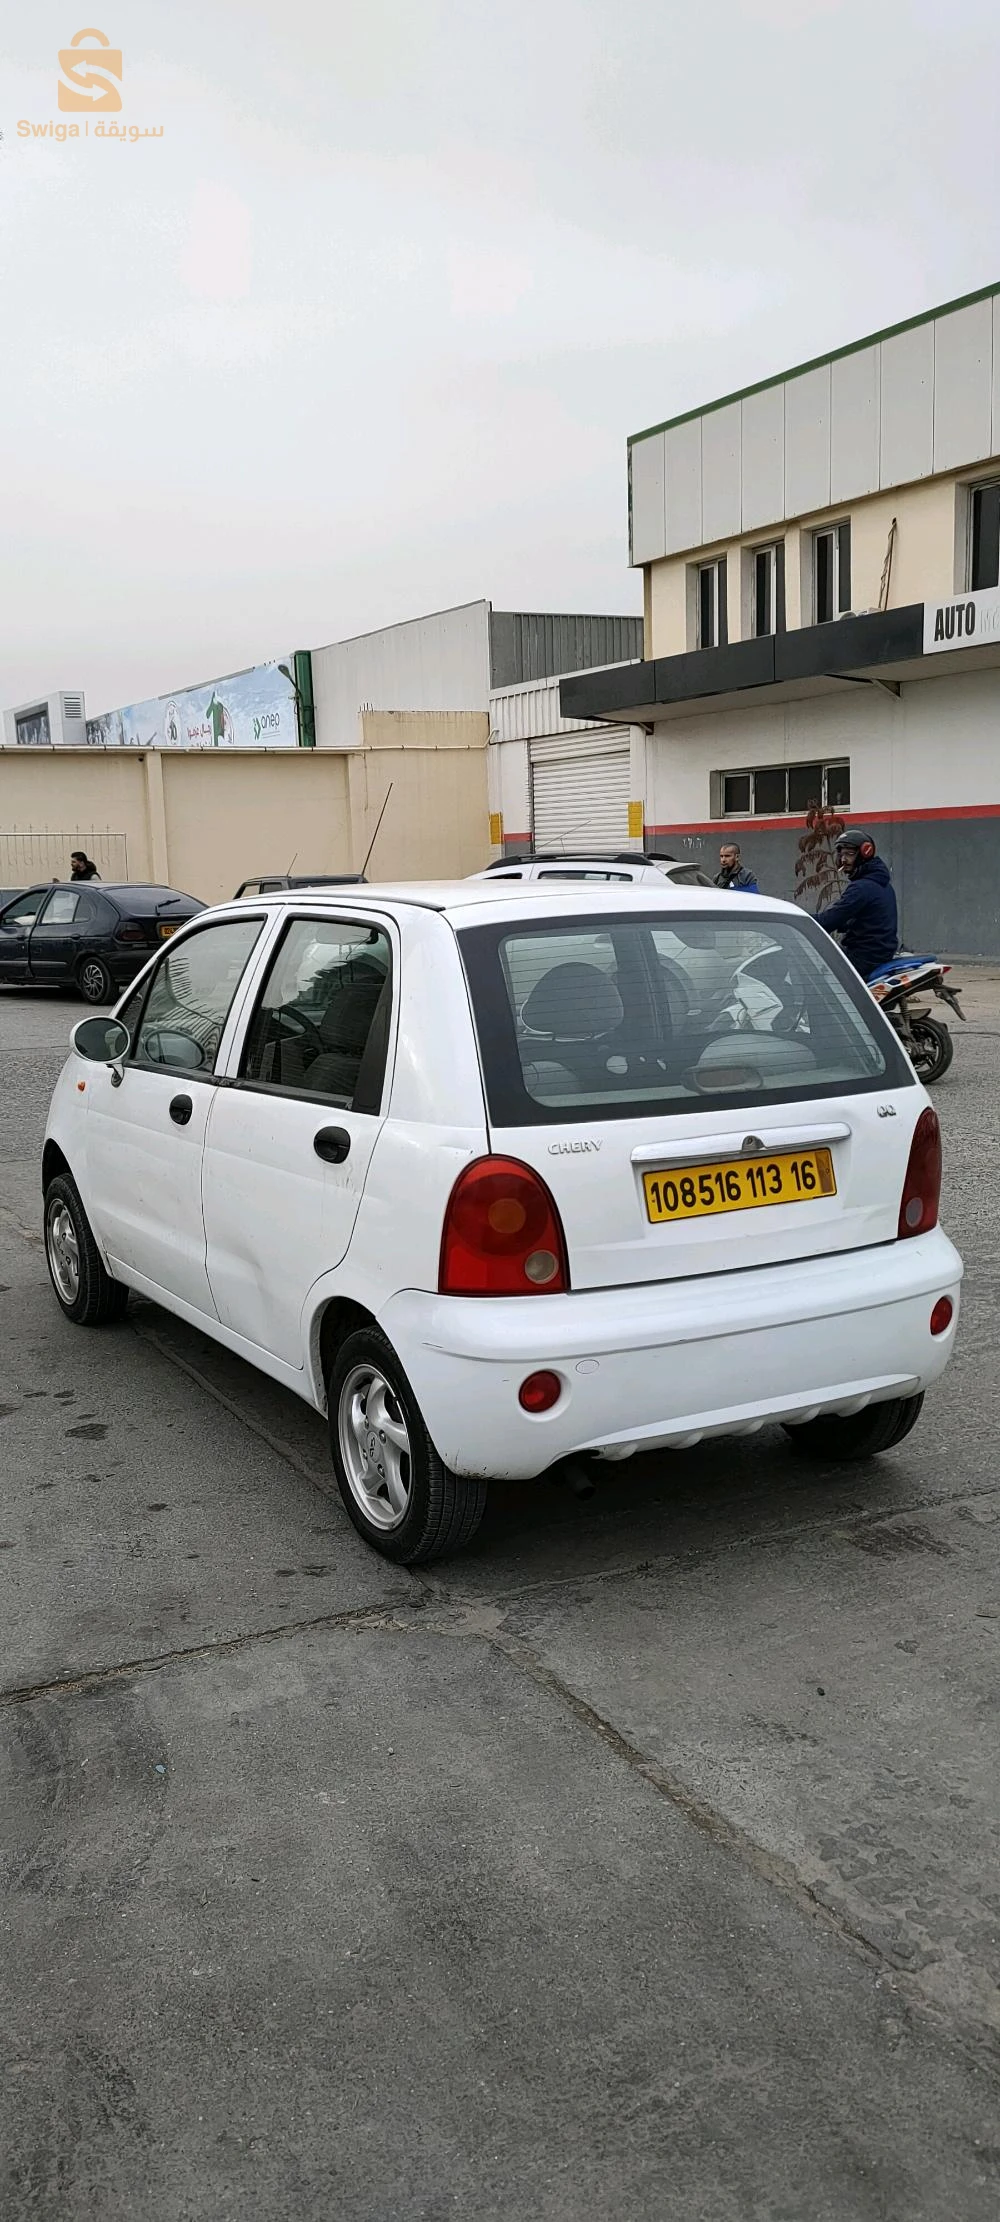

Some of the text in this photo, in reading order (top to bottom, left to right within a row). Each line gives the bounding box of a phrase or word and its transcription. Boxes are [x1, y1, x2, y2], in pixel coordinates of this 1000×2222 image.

[934, 601, 976, 642] AUTO
[547, 1140, 603, 1155] CHERY
[650, 1160, 816, 1213] 108516 113 16
